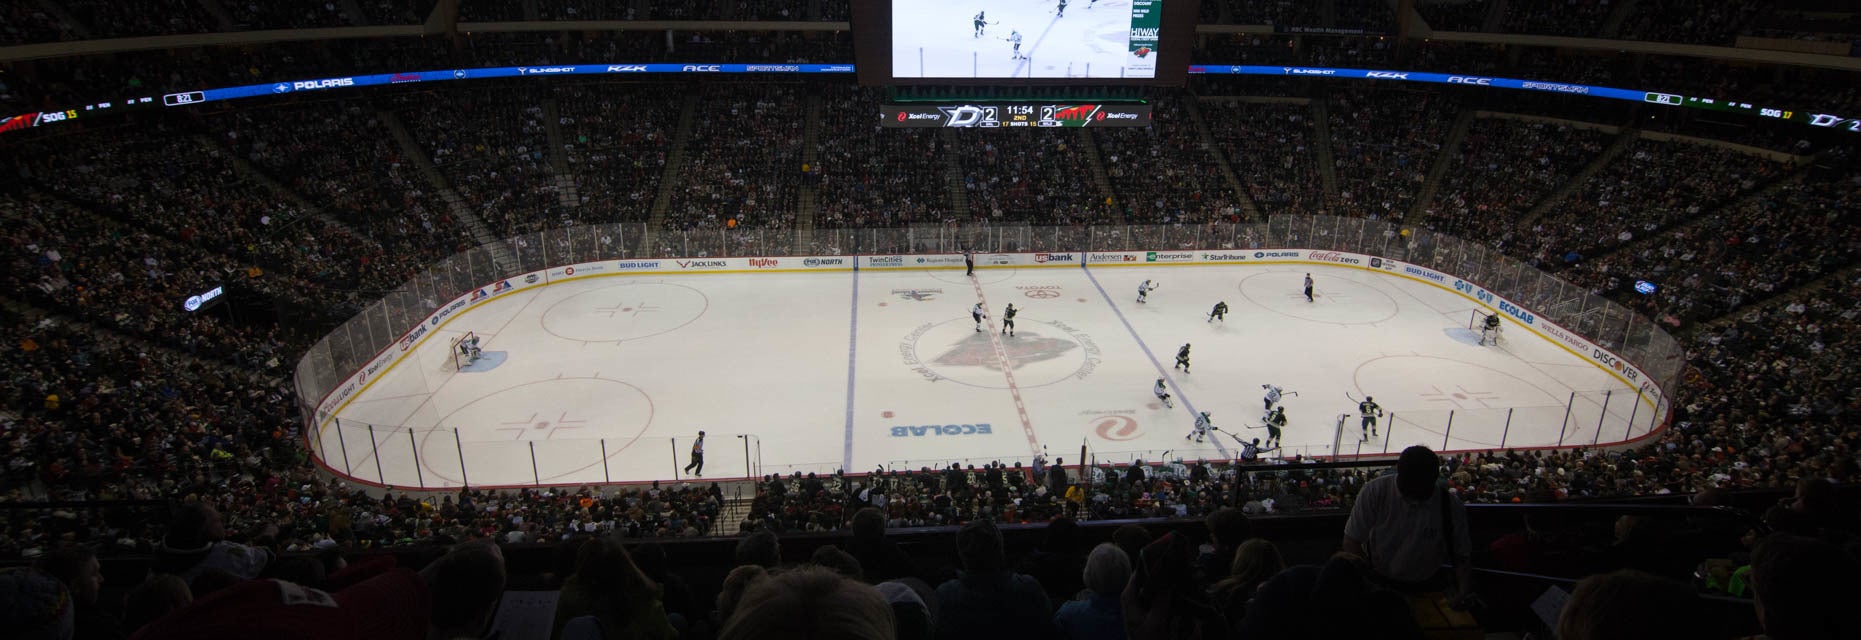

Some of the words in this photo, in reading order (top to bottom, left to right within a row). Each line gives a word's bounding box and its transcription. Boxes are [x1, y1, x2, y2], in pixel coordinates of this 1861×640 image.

[1130, 27, 1159, 37] HIWAY
[294, 77, 355, 91] POLARIS
[1447, 76, 1492, 86] ACE
[1522, 81, 1590, 94] SPORTSMAN
[985, 108, 995, 120] 2
[1007, 105, 1034, 115] 11:54
[1043, 108, 1053, 120] 2
[1760, 108, 1781, 118] SOG
[1782, 110, 1793, 119] 17
[42, 111, 67, 124] SOG
[66, 109, 77, 119] 15
[1849, 119, 1860, 131] 2
[1090, 252, 1122, 262] Andersen
[1340, 256, 1359, 265] zero
[1405, 266, 1422, 276] BUD
[1422, 270, 1445, 282] LIGHT
[439, 299, 466, 319] POLARIS
[1498, 300, 1534, 325] ECOLAB
[1540, 321, 1565, 341] WELLS
[1564, 334, 1589, 352] FARGO
[1593, 348, 1639, 383] DISCOVER
[890, 423, 993, 437] ECOLAB
